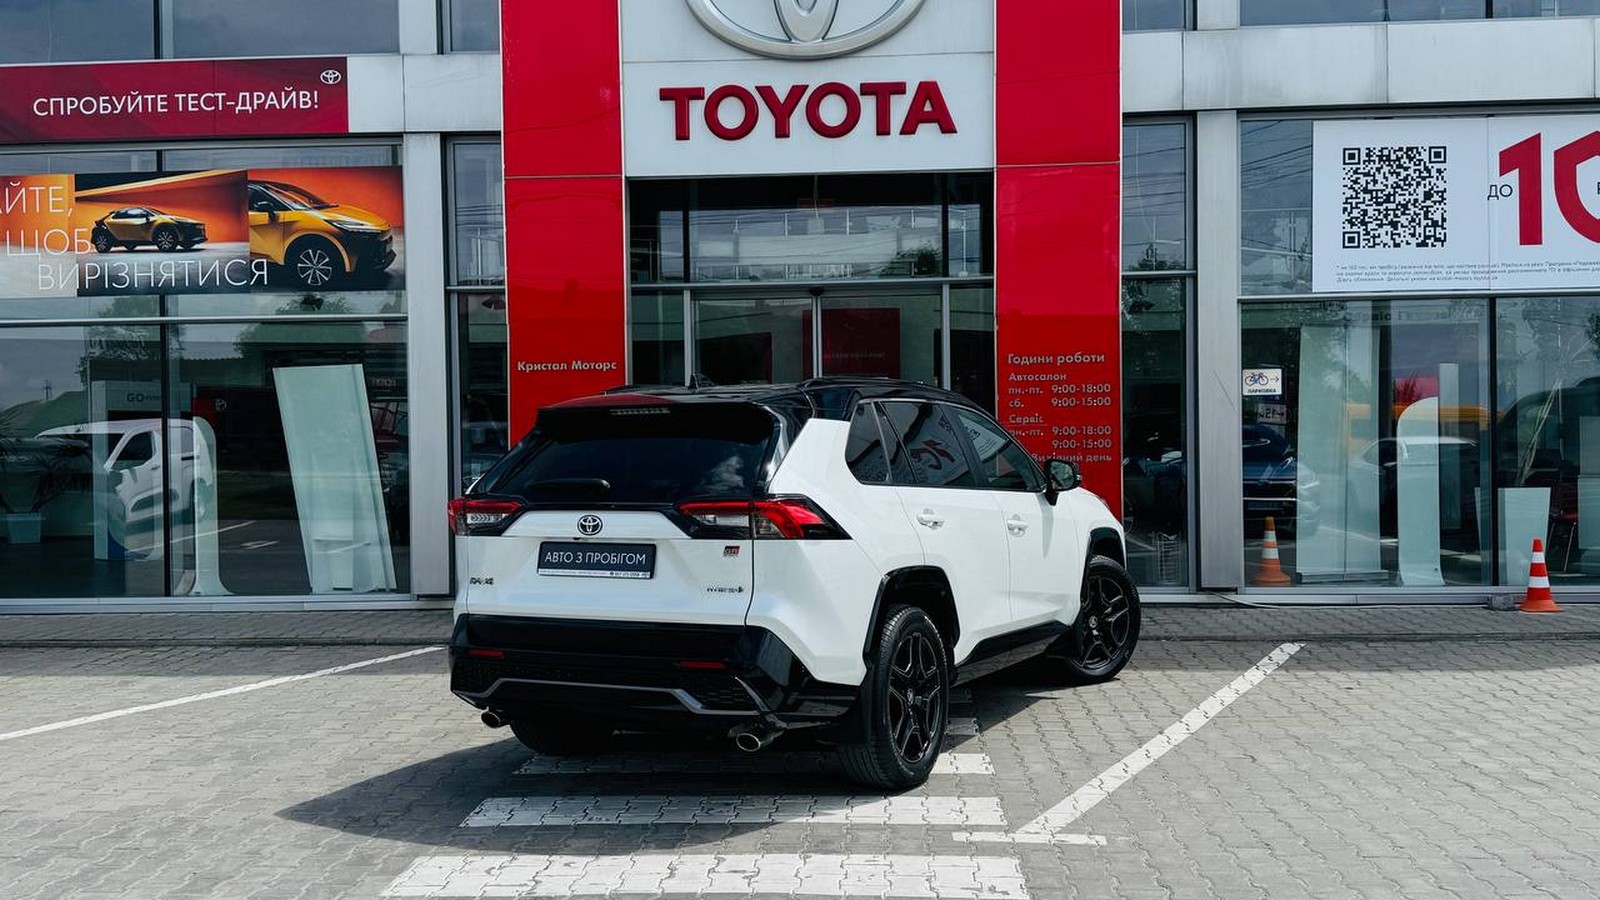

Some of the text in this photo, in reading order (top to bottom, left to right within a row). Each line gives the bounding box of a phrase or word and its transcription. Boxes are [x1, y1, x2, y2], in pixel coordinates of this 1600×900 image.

[33, 86, 319, 117] СПРОБУЙТЕ ТЕСТ-ДРАЙВ!
[659, 80, 958, 141] TOYOTA
[0, 181, 73, 218] ЙТЕ,
[6, 227, 92, 262] ЩОБ
[37, 258, 269, 291] ВИРІЗНЯТИСЯ
[1008, 352, 1105, 366] Години роботи
[517, 360, 617, 373] Кристал Моторс
[1008, 373, 1067, 381] Автосалон
[1008, 398, 1025, 408] сб.
[1009, 413, 1044, 424] Сервіс
[544, 551, 574, 564] АВТО
[585, 551, 646, 565] ПРОБІГОМ
